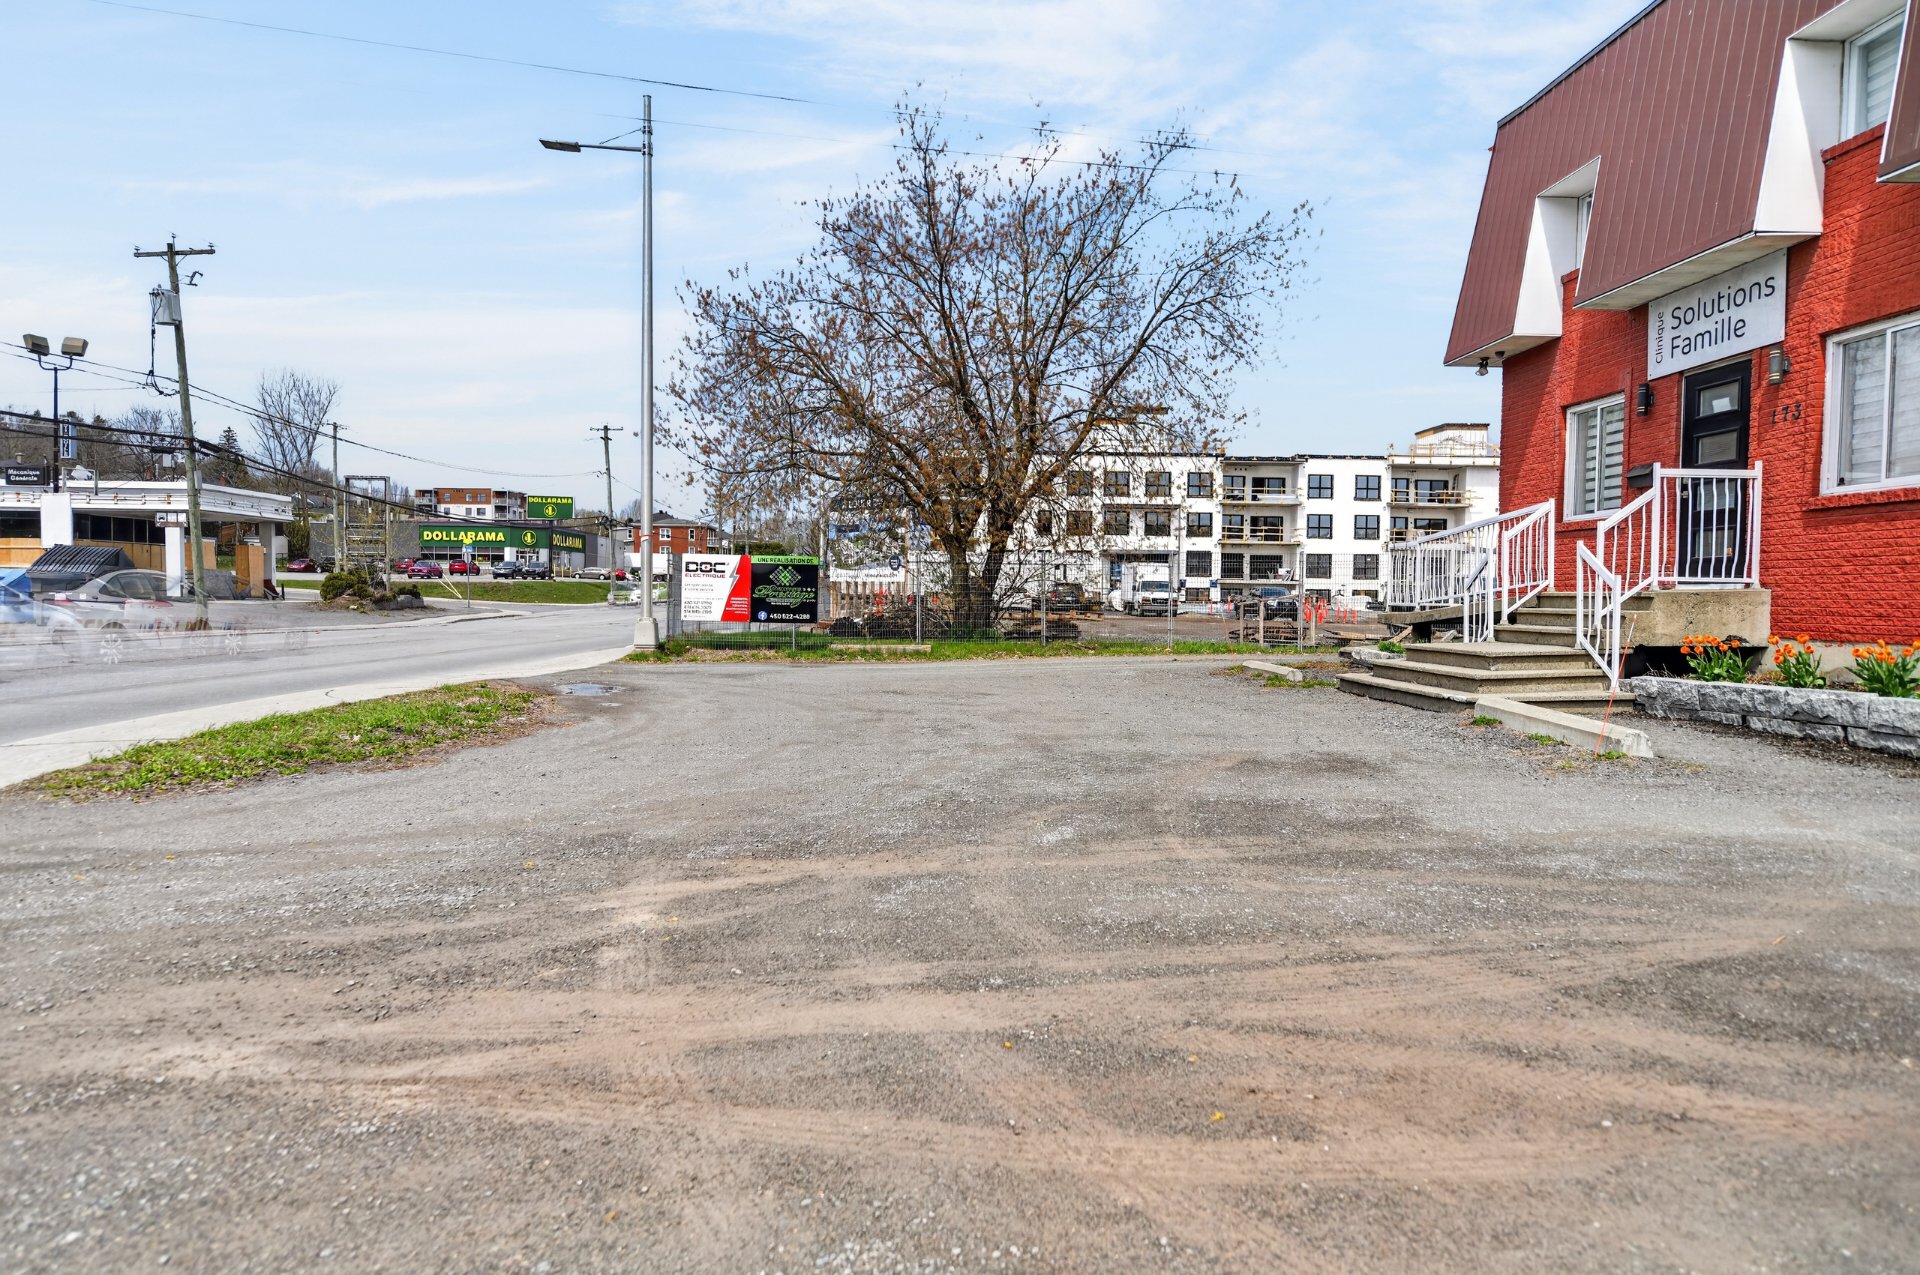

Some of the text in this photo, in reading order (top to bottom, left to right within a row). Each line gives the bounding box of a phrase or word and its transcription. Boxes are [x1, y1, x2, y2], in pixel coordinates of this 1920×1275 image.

[1671, 276, 1776, 330] Solutions
[1655, 311, 1666, 364] Clinique
[1671, 316, 1746, 359] Famille
[1772, 402, 1801, 425] 173
[528, 496, 572, 504] DOLLARAMA
[423, 531, 505, 542] DOLLARAMA
[552, 533, 583, 549] DOLLARAMA
[685, 561, 726, 573] DOC
